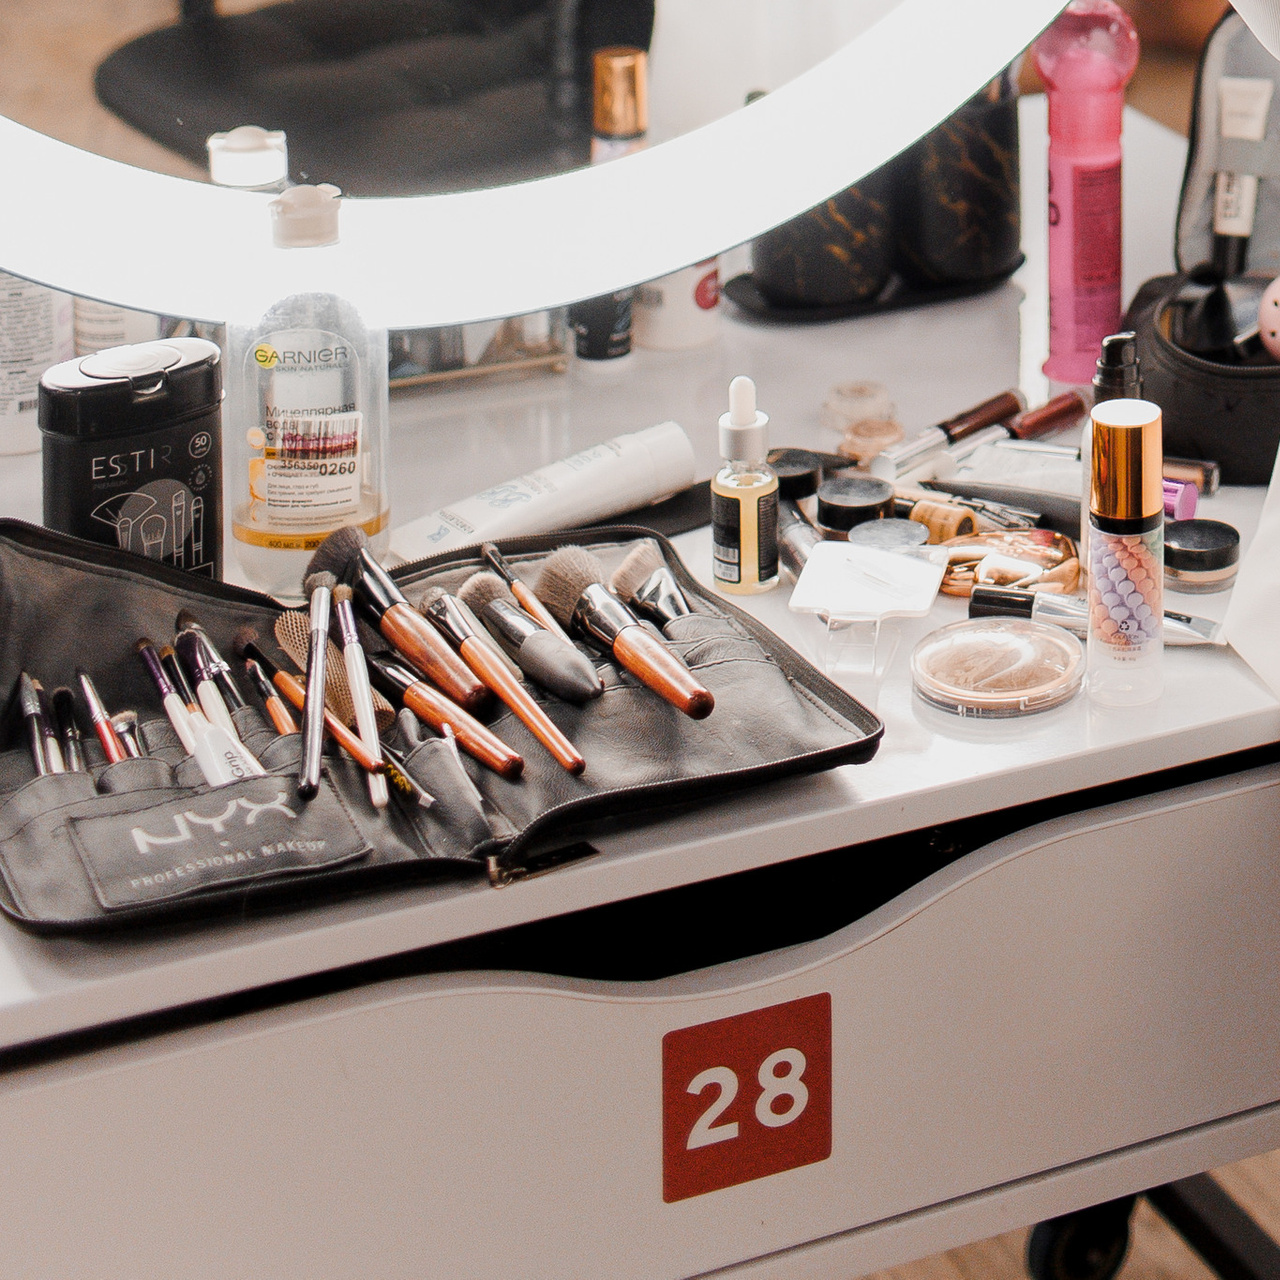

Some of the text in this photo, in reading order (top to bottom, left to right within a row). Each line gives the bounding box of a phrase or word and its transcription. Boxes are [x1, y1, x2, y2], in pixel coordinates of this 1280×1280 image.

[254, 346, 348, 364] GARNIER
[275, 362, 350, 373] SKIN NATURALS
[265, 402, 356, 419] Мицеллярная
[195, 435, 207, 448] 50
[281, 459, 319, 471] 356350
[319, 461, 356, 476] 0260
[224, 750, 245, 778] Grip
[131, 791, 297, 854] NYX
[130, 840, 327, 888] PROFESSIONAL MAKEUP
[686, 1047, 809, 1151] 28
